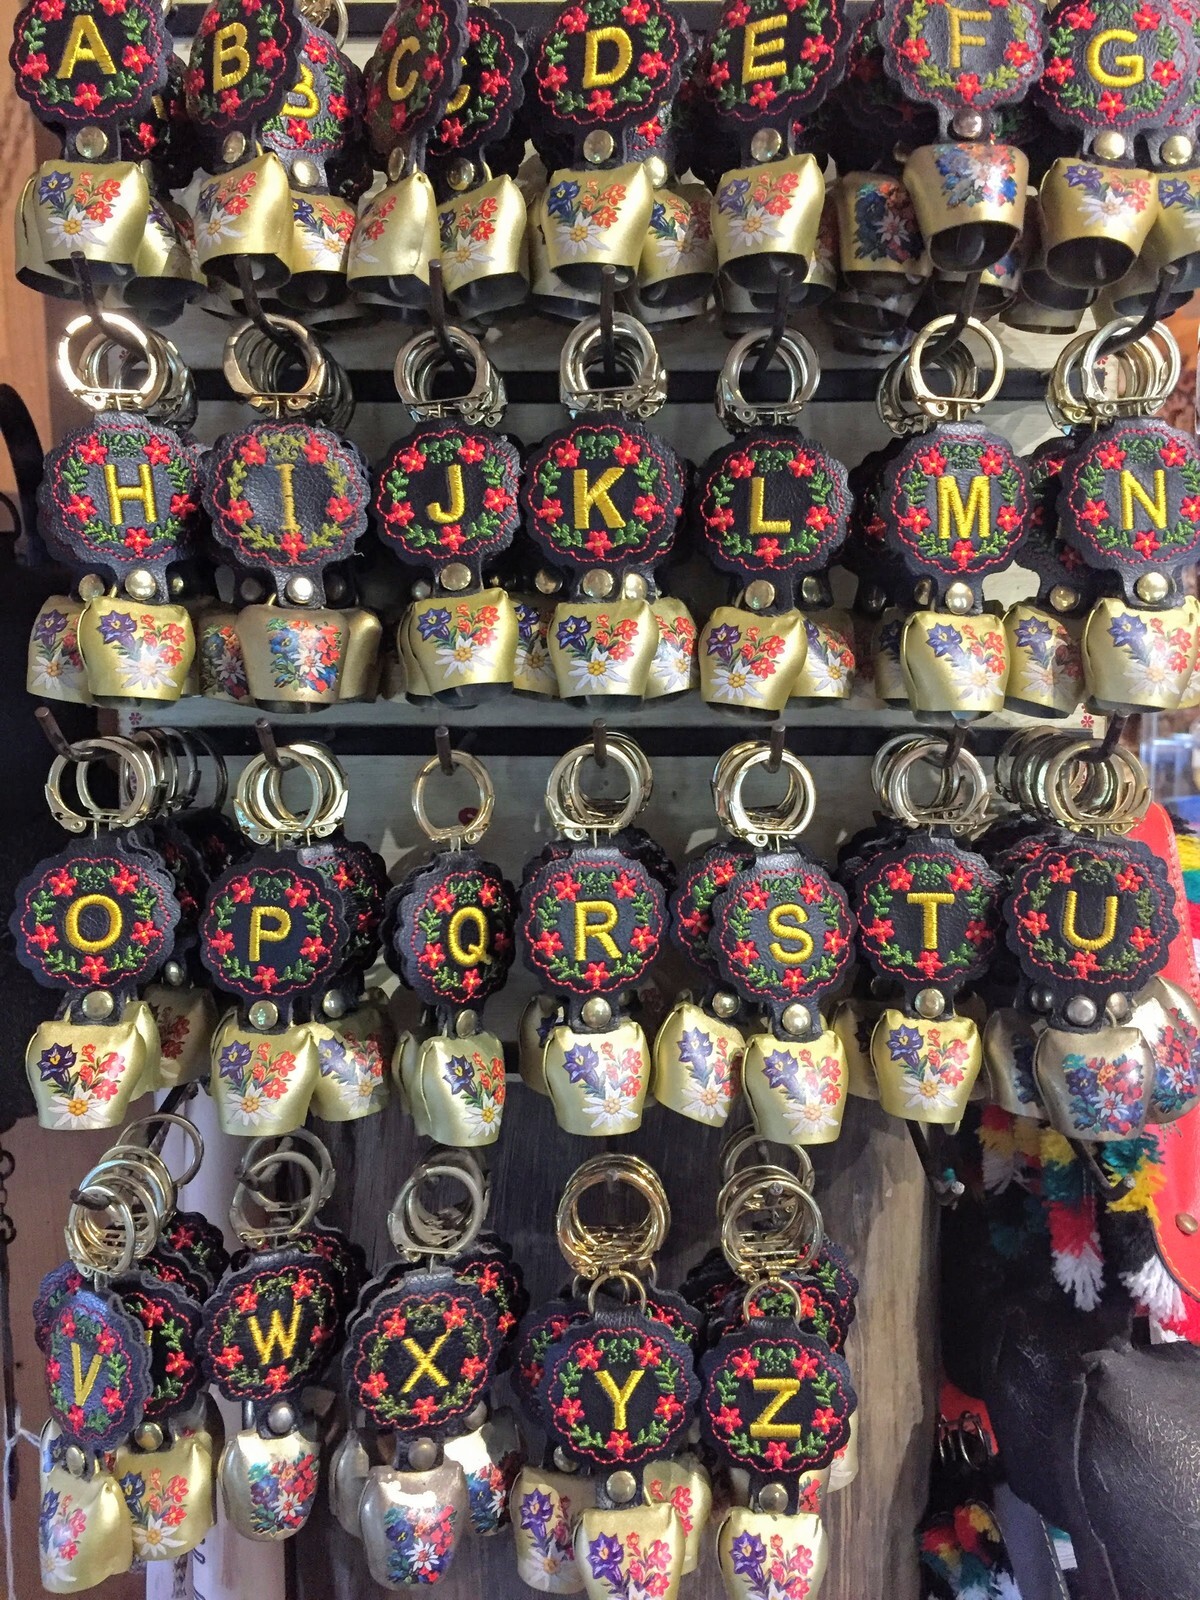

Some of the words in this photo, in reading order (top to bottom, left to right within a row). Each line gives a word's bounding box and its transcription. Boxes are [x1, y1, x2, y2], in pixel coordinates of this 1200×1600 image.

[57, 16, 117, 79] A
[213, 22, 250, 93] B
[582, 27, 632, 90] D
[742, 15, 787, 84] E
[948, 8, 993, 69] F
[1086, 29, 1145, 88] G
[389, 38, 420, 100] C
[105, 465, 158, 525] H
[278, 464, 297, 532] I
[427, 465, 464, 523] J
[573, 468, 626, 529] K
[750, 477, 791, 534] L
[937, 475, 990, 539] M
[1120, 470, 1167, 530] N
[64, 894, 122, 953] O
[249, 907, 291, 961] P
[448, 907, 491, 967] Q
[575, 901, 621, 960] R
[768, 904, 814, 964] S
[906, 893, 954, 949] T
[1062, 891, 1117, 950] U
[248, 1304, 300, 1365] W
[402, 1334, 450, 1393] X
[70, 1342, 103, 1407] V
[596, 1370, 644, 1430] Y
[750, 1379, 801, 1438] Z
